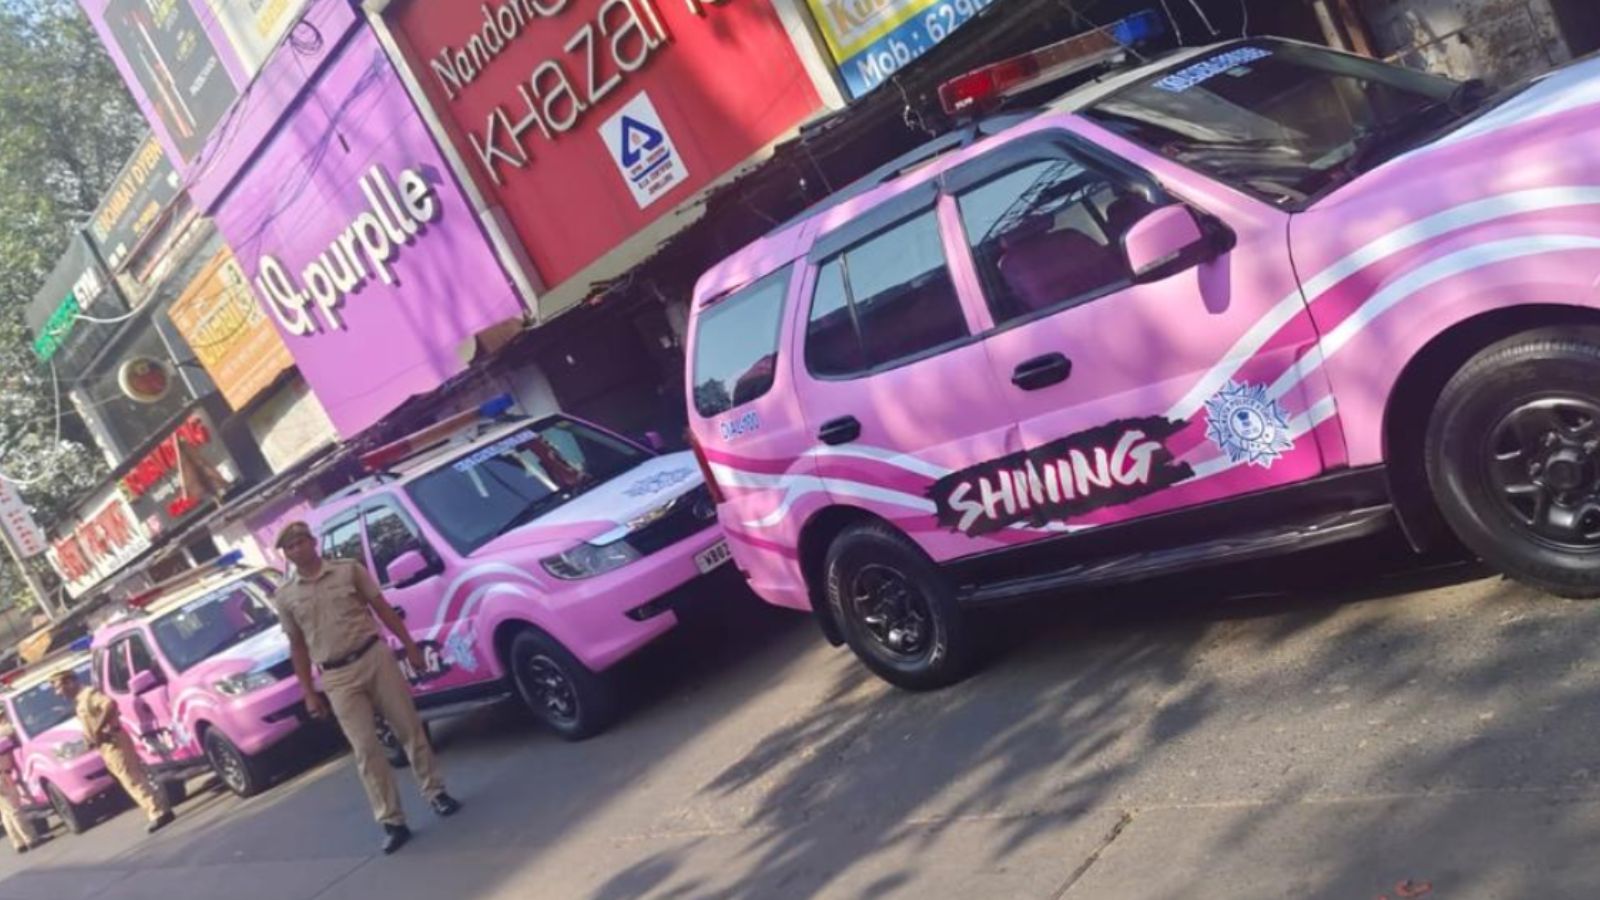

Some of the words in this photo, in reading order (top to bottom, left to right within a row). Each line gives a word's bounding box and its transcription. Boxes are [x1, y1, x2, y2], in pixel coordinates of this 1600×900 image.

[926, 0, 993, 43] 629
[302, 163, 433, 331] purplle
[948, 429, 1163, 532] SHINING
